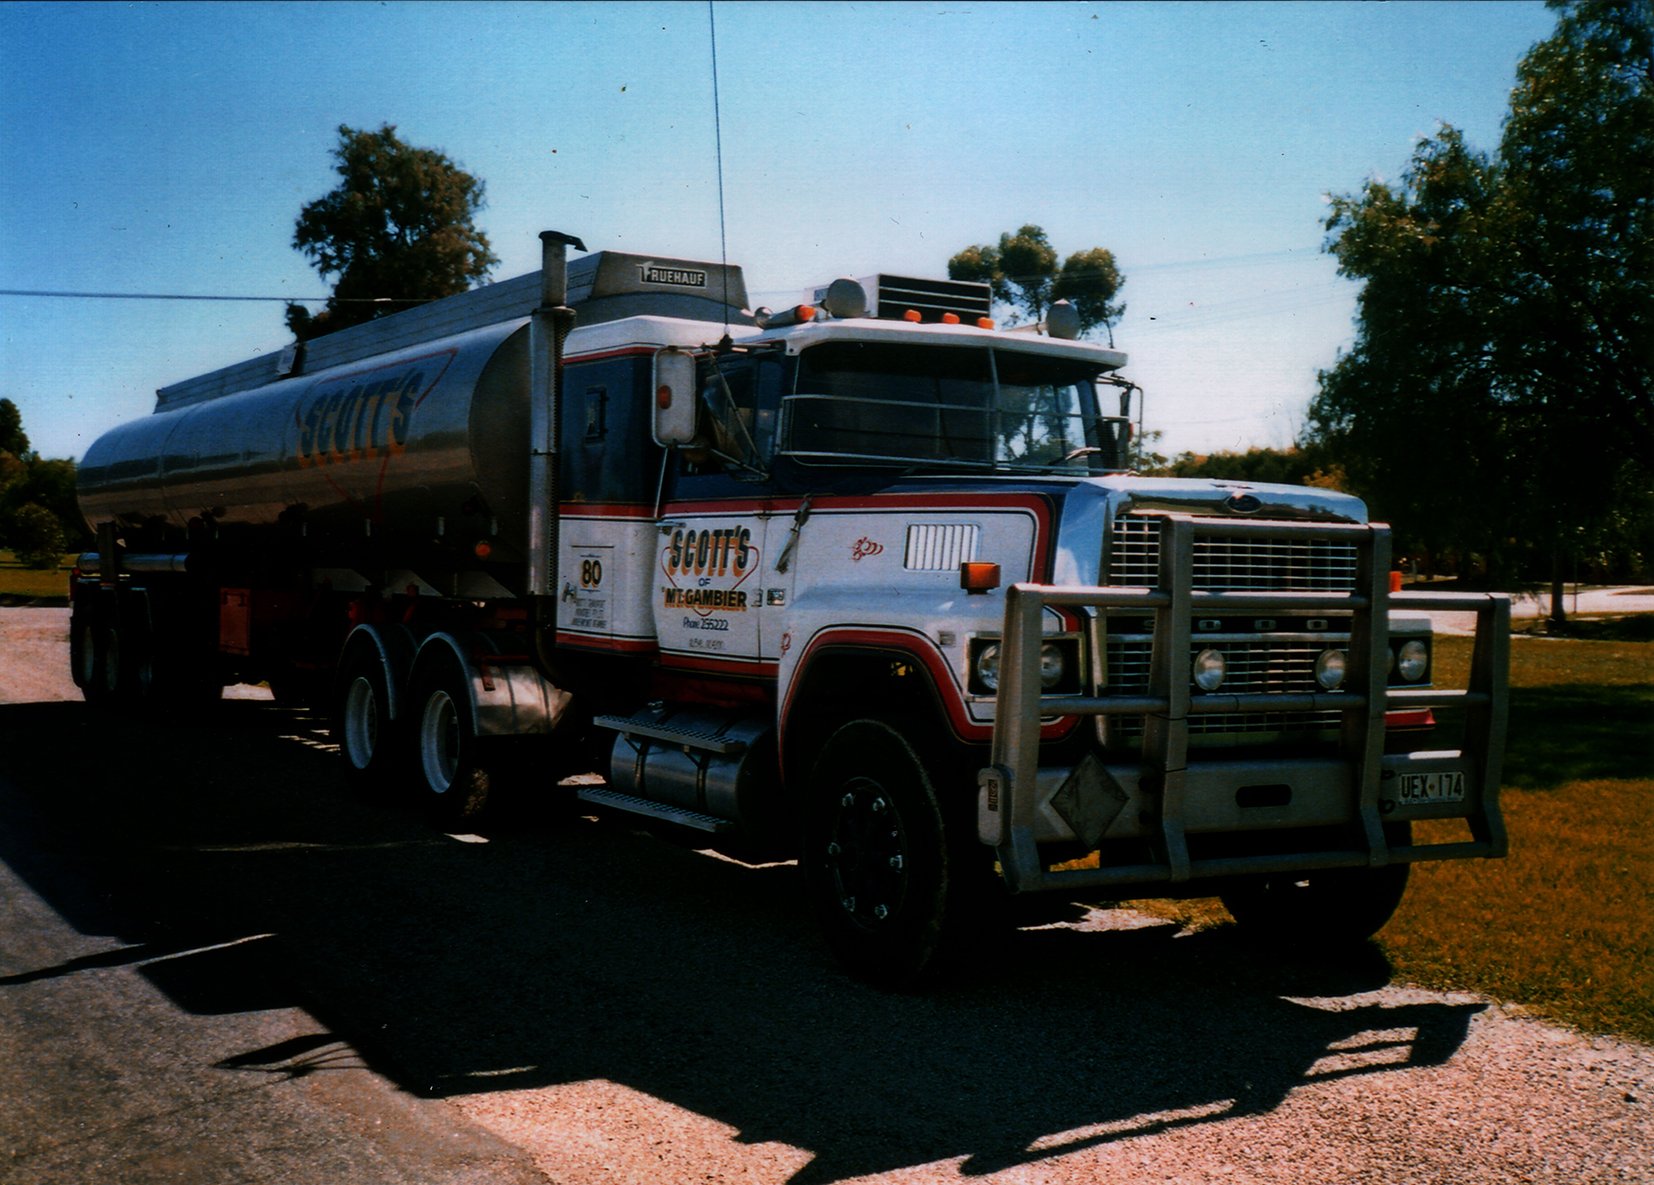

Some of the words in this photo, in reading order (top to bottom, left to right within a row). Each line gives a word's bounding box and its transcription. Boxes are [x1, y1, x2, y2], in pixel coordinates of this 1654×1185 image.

[635, 261, 704, 285] FRUEHAUF
[669, 526, 750, 576] SCOTT'S
[581, 560, 602, 587] 80
[698, 578, 711, 587] OF
